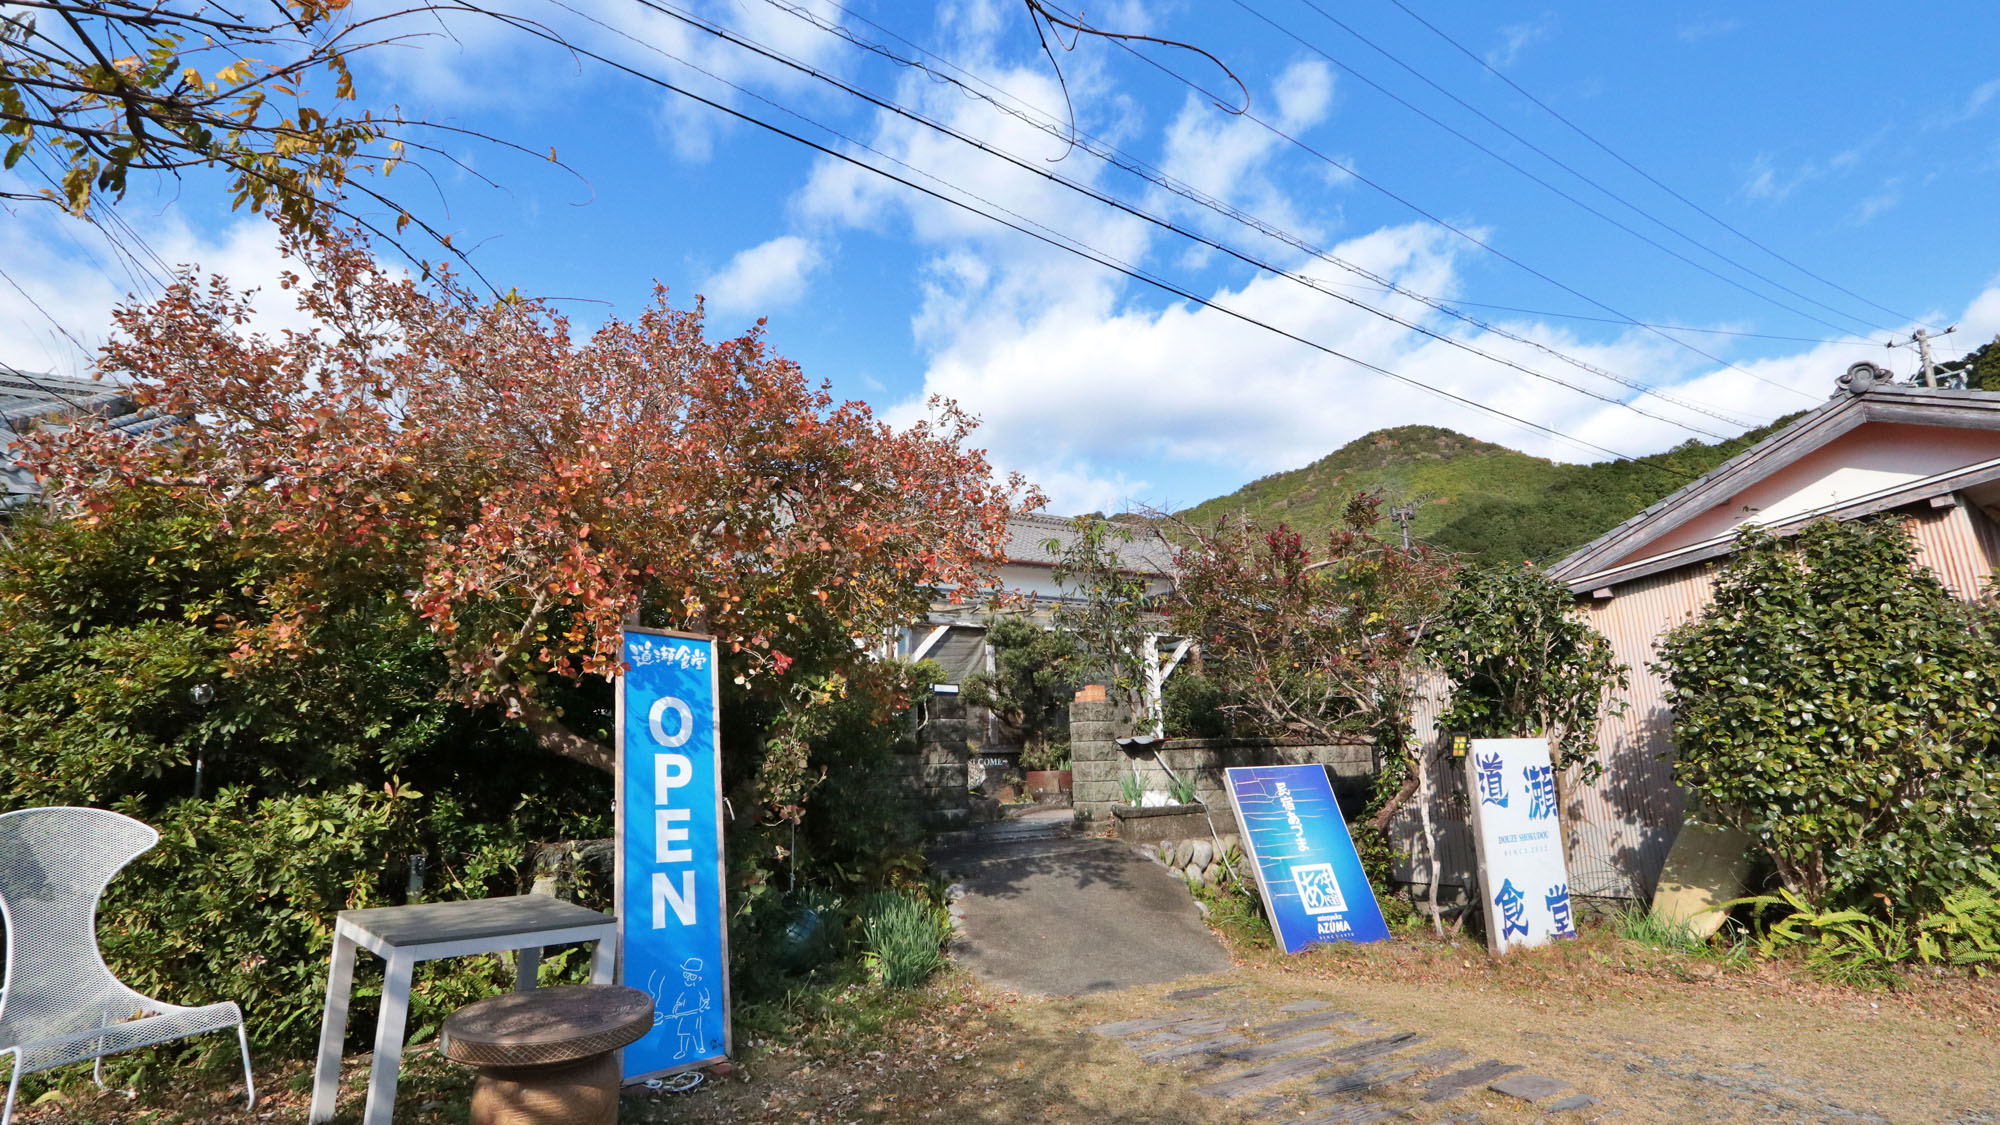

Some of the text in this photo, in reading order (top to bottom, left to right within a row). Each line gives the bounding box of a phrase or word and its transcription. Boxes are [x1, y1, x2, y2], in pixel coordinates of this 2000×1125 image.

[629, 640, 707, 670] 道瀬食堂
[648, 696, 697, 930] OPEN
[1475, 752, 1557, 820] 道瀬
[1317, 920, 1352, 935] AZUMA
[1494, 877, 1577, 941] 食堂
